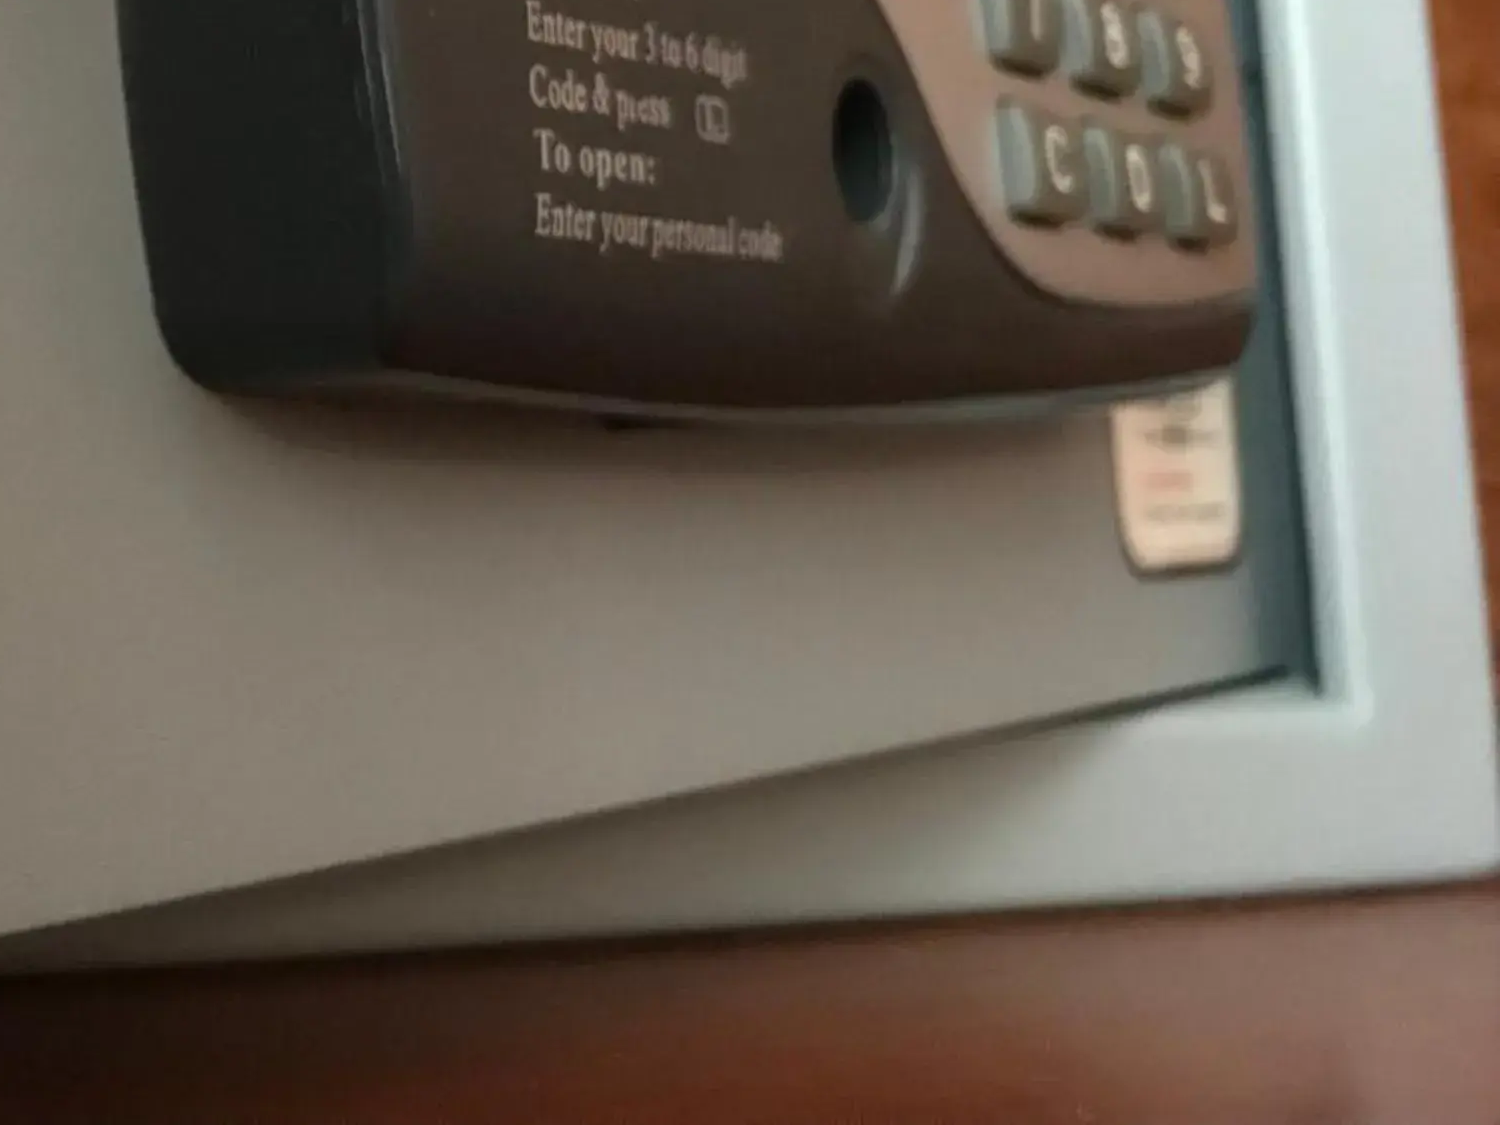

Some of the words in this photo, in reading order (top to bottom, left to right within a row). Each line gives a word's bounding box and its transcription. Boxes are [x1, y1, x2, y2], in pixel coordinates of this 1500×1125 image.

[590, 22, 639, 64] your
[661, 32, 683, 69] to
[685, 30, 700, 73] 6
[1101, 1, 1129, 69] 8
[1176, 26, 1200, 89] 9
[529, 63, 588, 114] Code
[592, 72, 610, 116] &
[616, 89, 672, 132] press
[533, 128, 571, 173] To
[579, 144, 656, 190] open:
[1045, 125, 1073, 194] C
[1125, 144, 1152, 213] 0
[535, 192, 596, 243] Enter
[601, 211, 649, 254] your
[652, 216, 734, 259] personal
[738, 221, 783, 263] code
